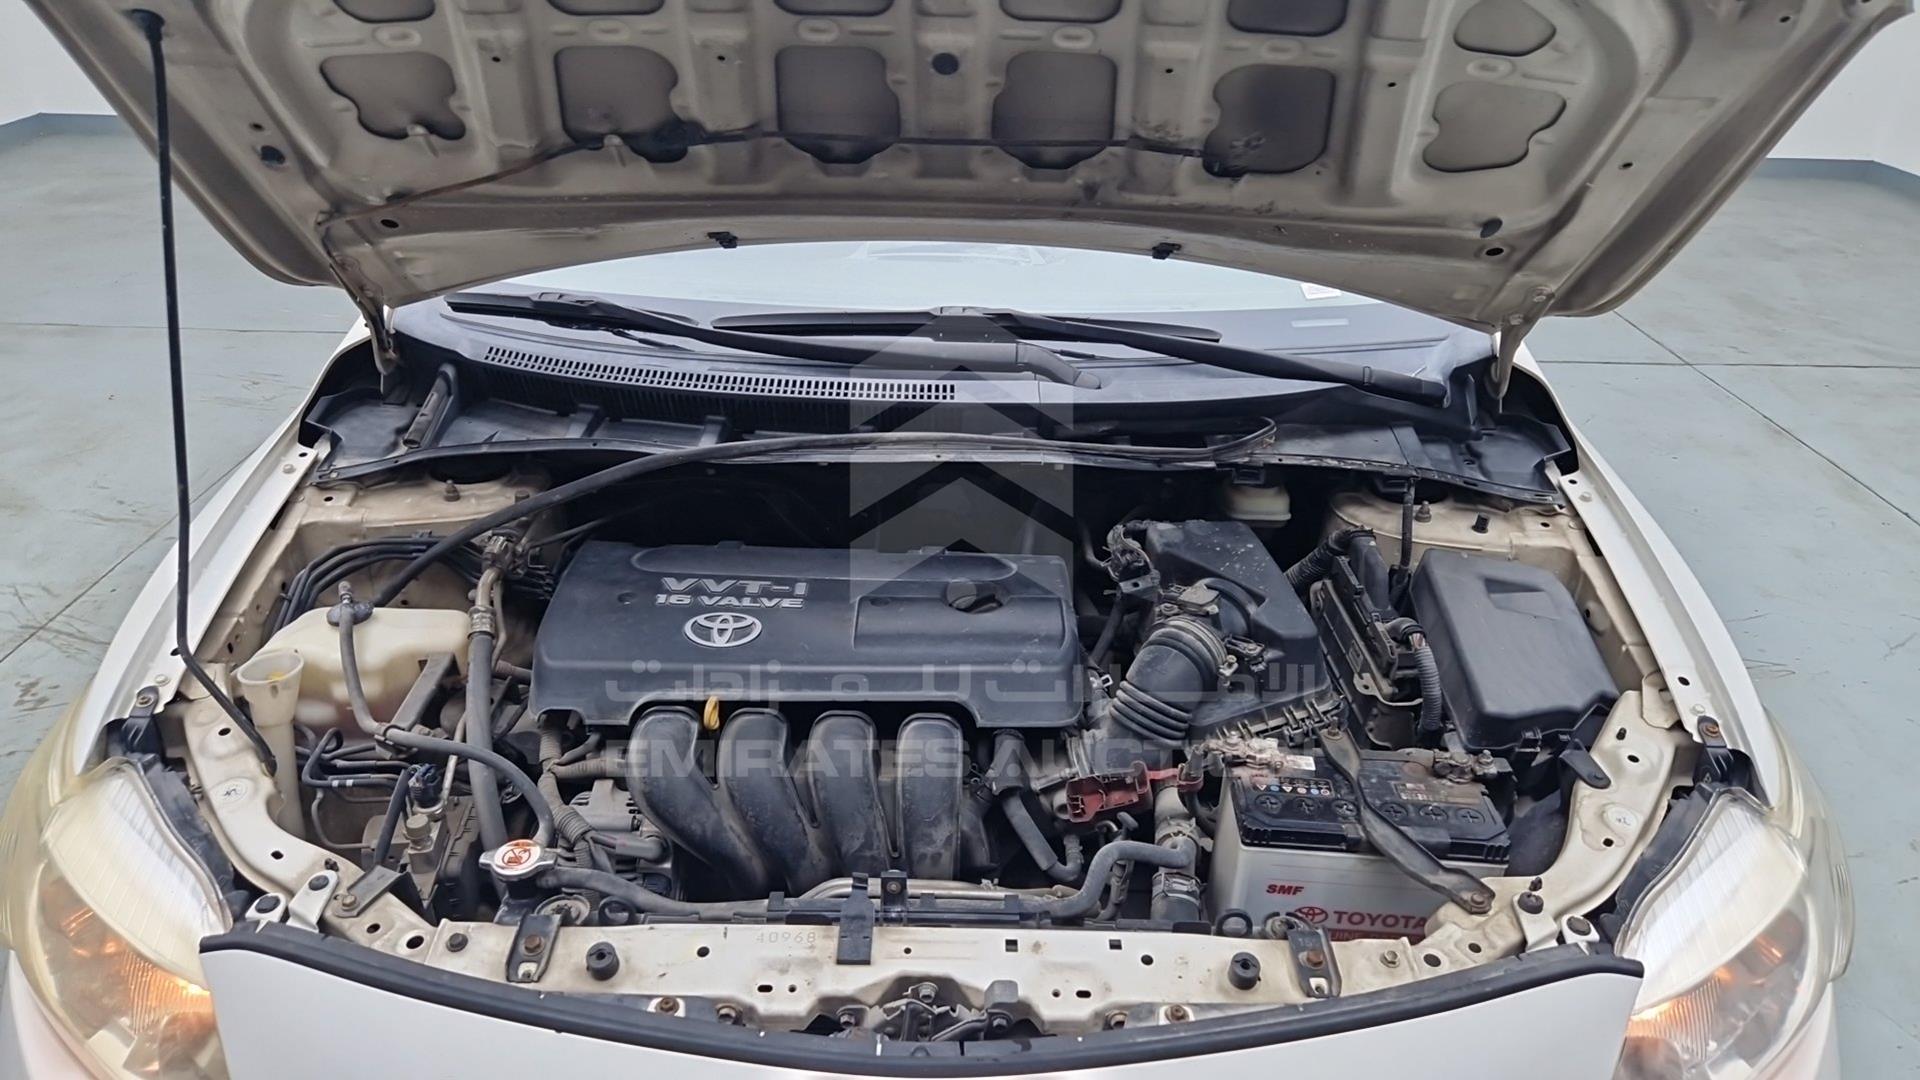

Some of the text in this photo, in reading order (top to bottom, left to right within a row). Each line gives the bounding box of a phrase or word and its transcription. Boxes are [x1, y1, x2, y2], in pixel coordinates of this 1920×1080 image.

[656, 593, 804, 608] 16 VALVE
[1266, 884, 1304, 896] SMF
[1333, 910, 1427, 929] TOYOTA
